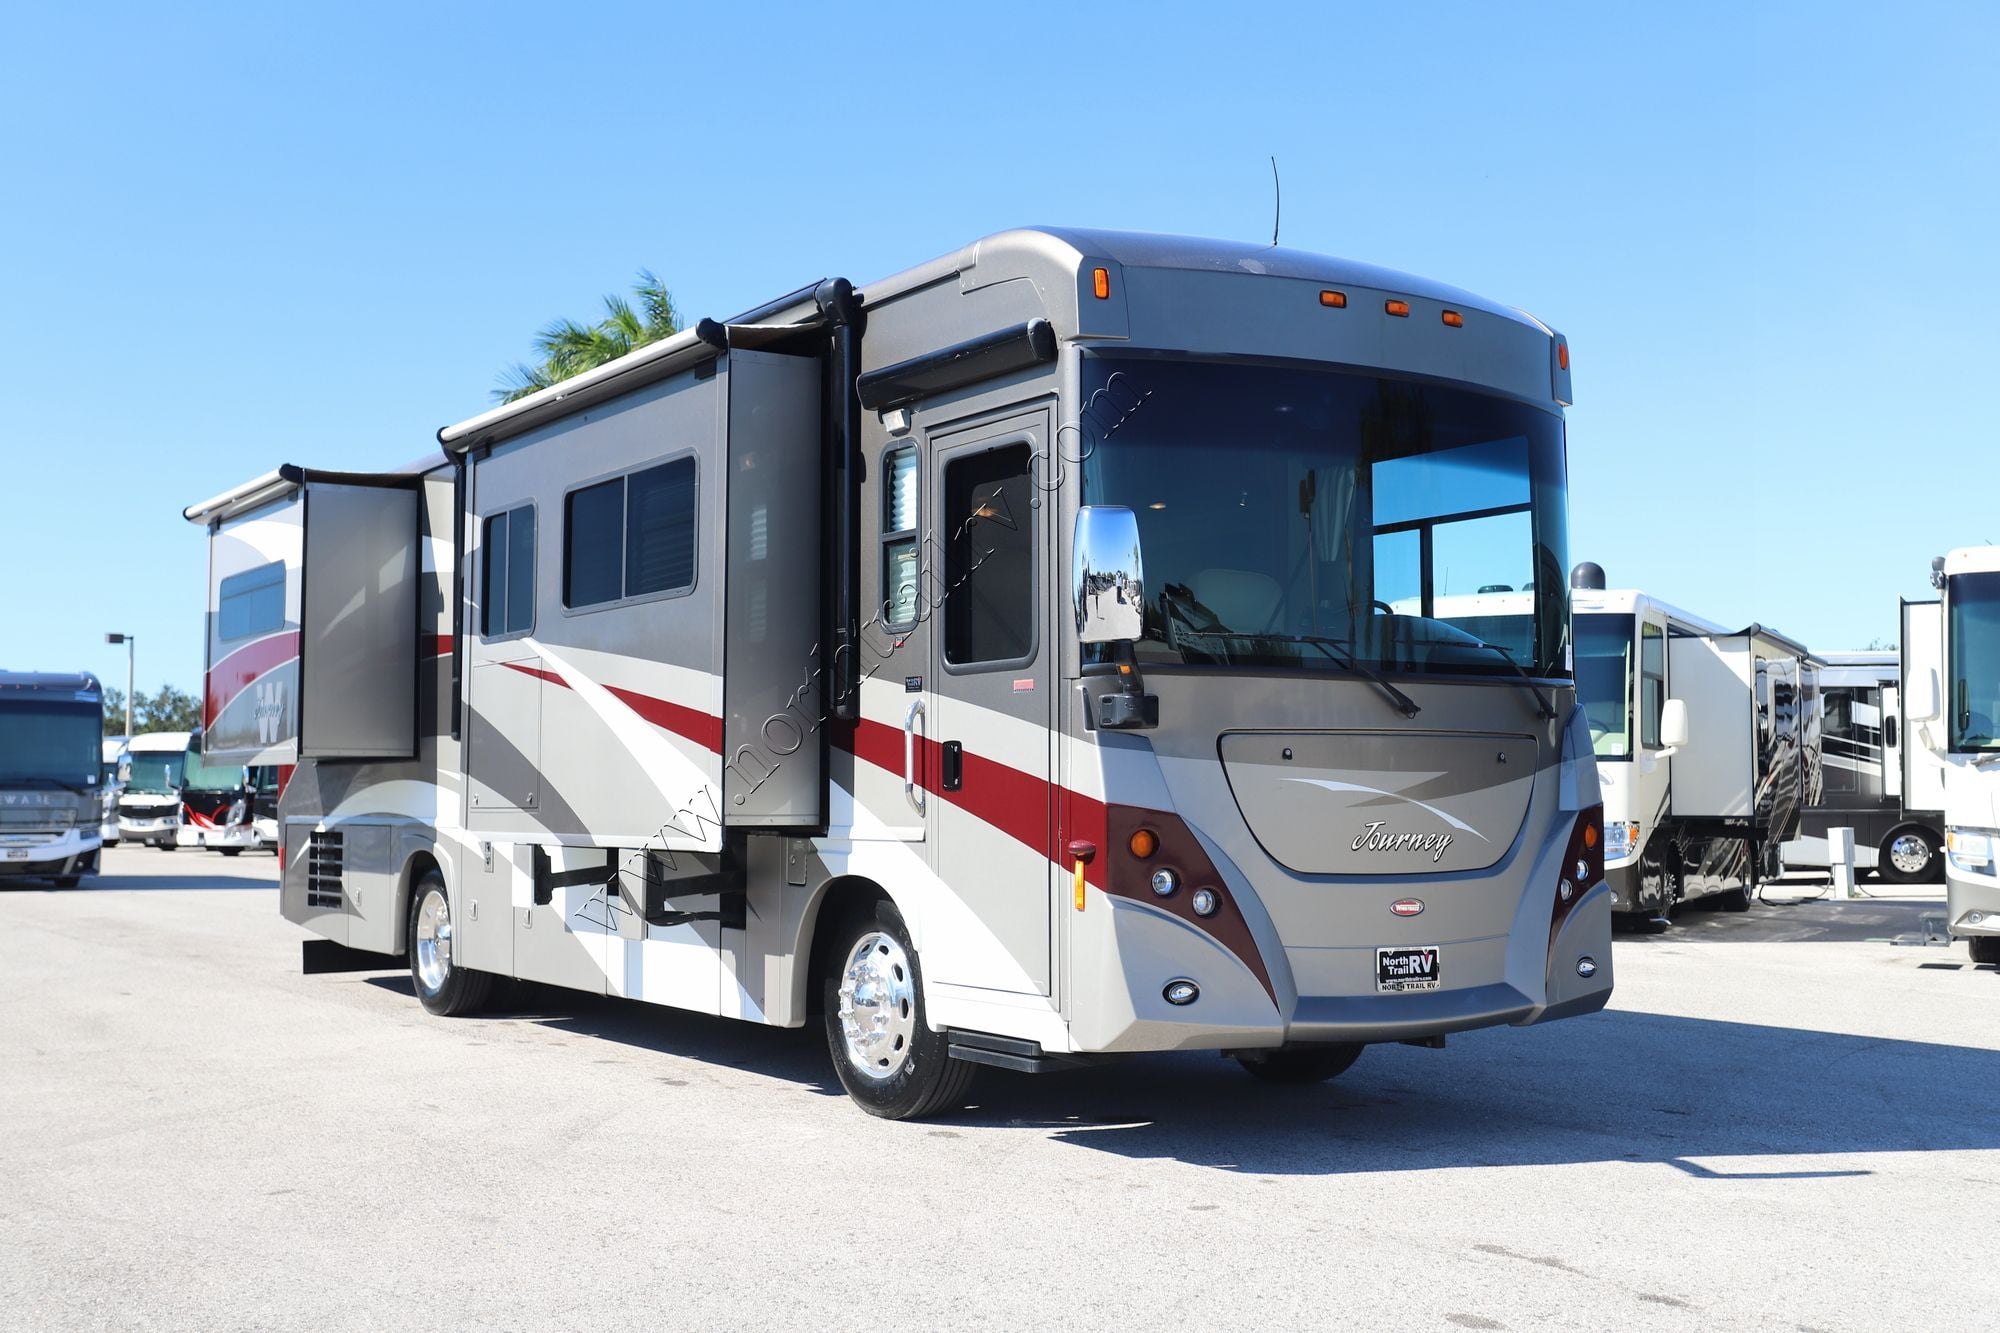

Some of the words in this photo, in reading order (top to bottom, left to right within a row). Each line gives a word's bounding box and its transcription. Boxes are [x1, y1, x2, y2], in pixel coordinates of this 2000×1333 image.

[1351, 820, 1453, 863] Journey
[1382, 955, 1408, 966] North
[1409, 954, 1433, 974] RV
[1387, 966, 1409, 975] Trail
[1407, 982, 1425, 990] TRAIL
[1427, 981, 1436, 989] RV
